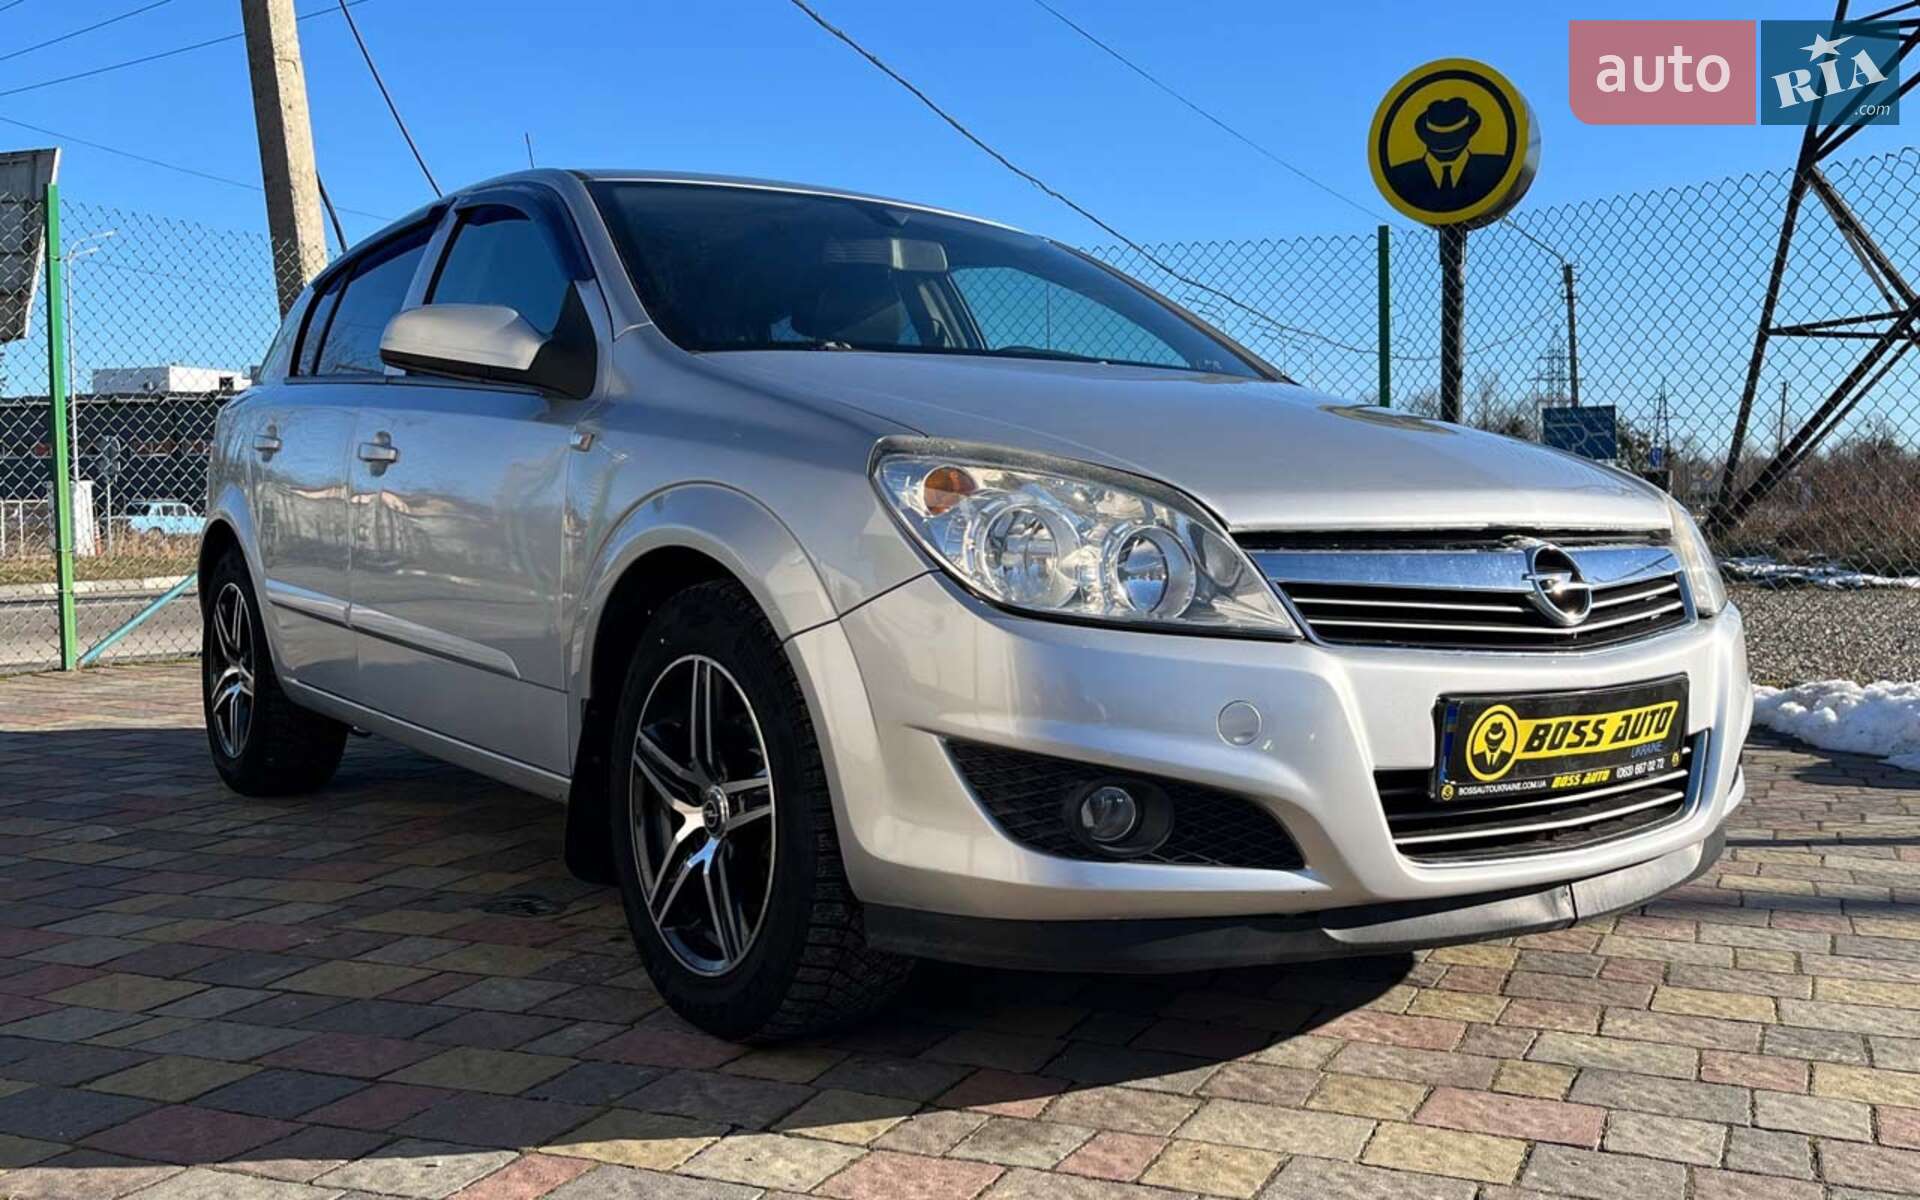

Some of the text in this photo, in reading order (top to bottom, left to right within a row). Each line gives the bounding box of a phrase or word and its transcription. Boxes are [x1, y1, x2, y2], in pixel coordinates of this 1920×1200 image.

[1522, 706, 1673, 753] BOSS AUTO
[1631, 741, 1664, 758] UKRAINE
[1551, 769, 1611, 789] BOSS AUTO
